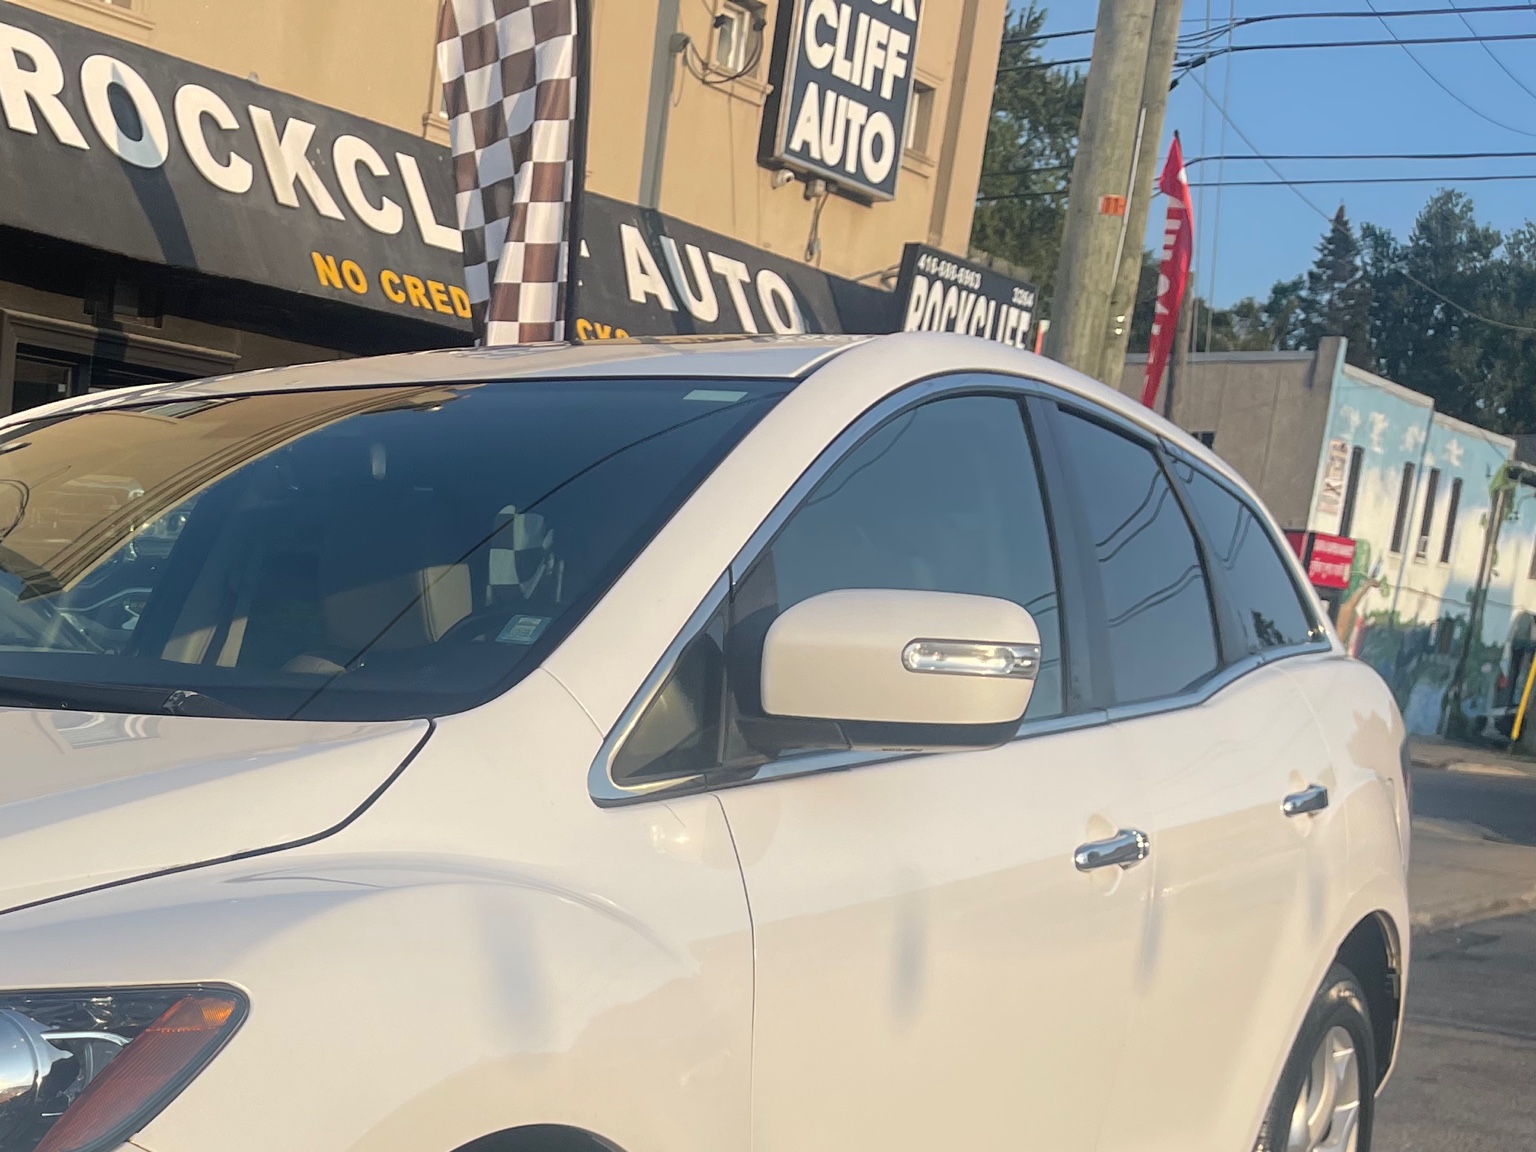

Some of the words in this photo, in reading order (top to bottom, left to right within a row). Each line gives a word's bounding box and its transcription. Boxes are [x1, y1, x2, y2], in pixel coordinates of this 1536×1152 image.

[804, 0, 911, 101] CLIFF
[789, 81, 896, 184] AUTO
[310, 250, 369, 296] NO
[379, 268, 473, 320] CRED
[619, 222, 806, 335] AUTO
